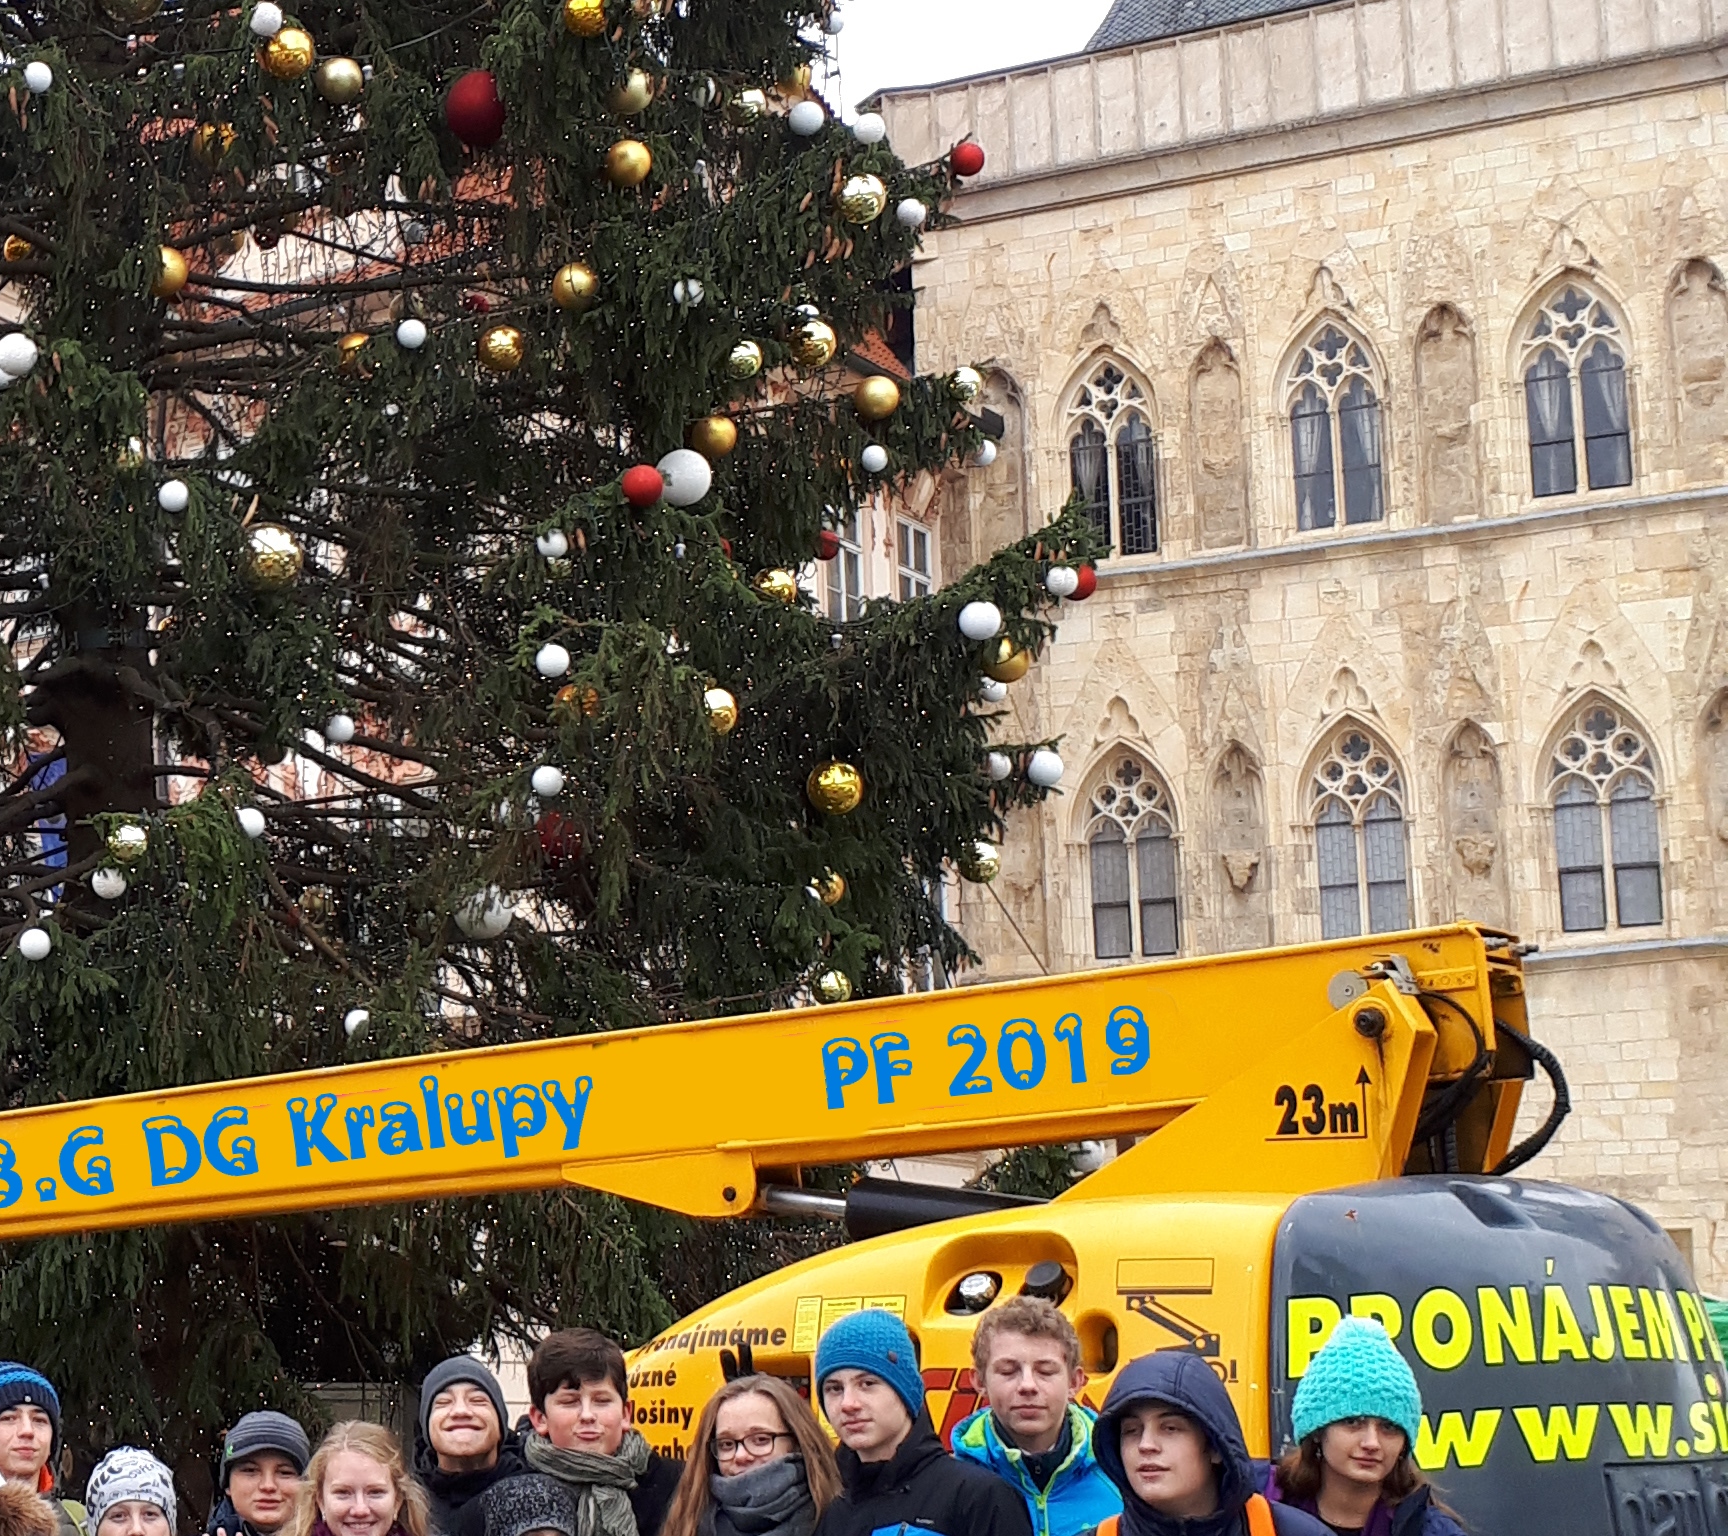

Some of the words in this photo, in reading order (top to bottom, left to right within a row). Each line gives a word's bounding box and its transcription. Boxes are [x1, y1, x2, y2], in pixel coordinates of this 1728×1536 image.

[1274, 1083, 1359, 1136] 23m
[627, 1362, 677, 1389] ůzné
[631, 1399, 695, 1431] lošiny
